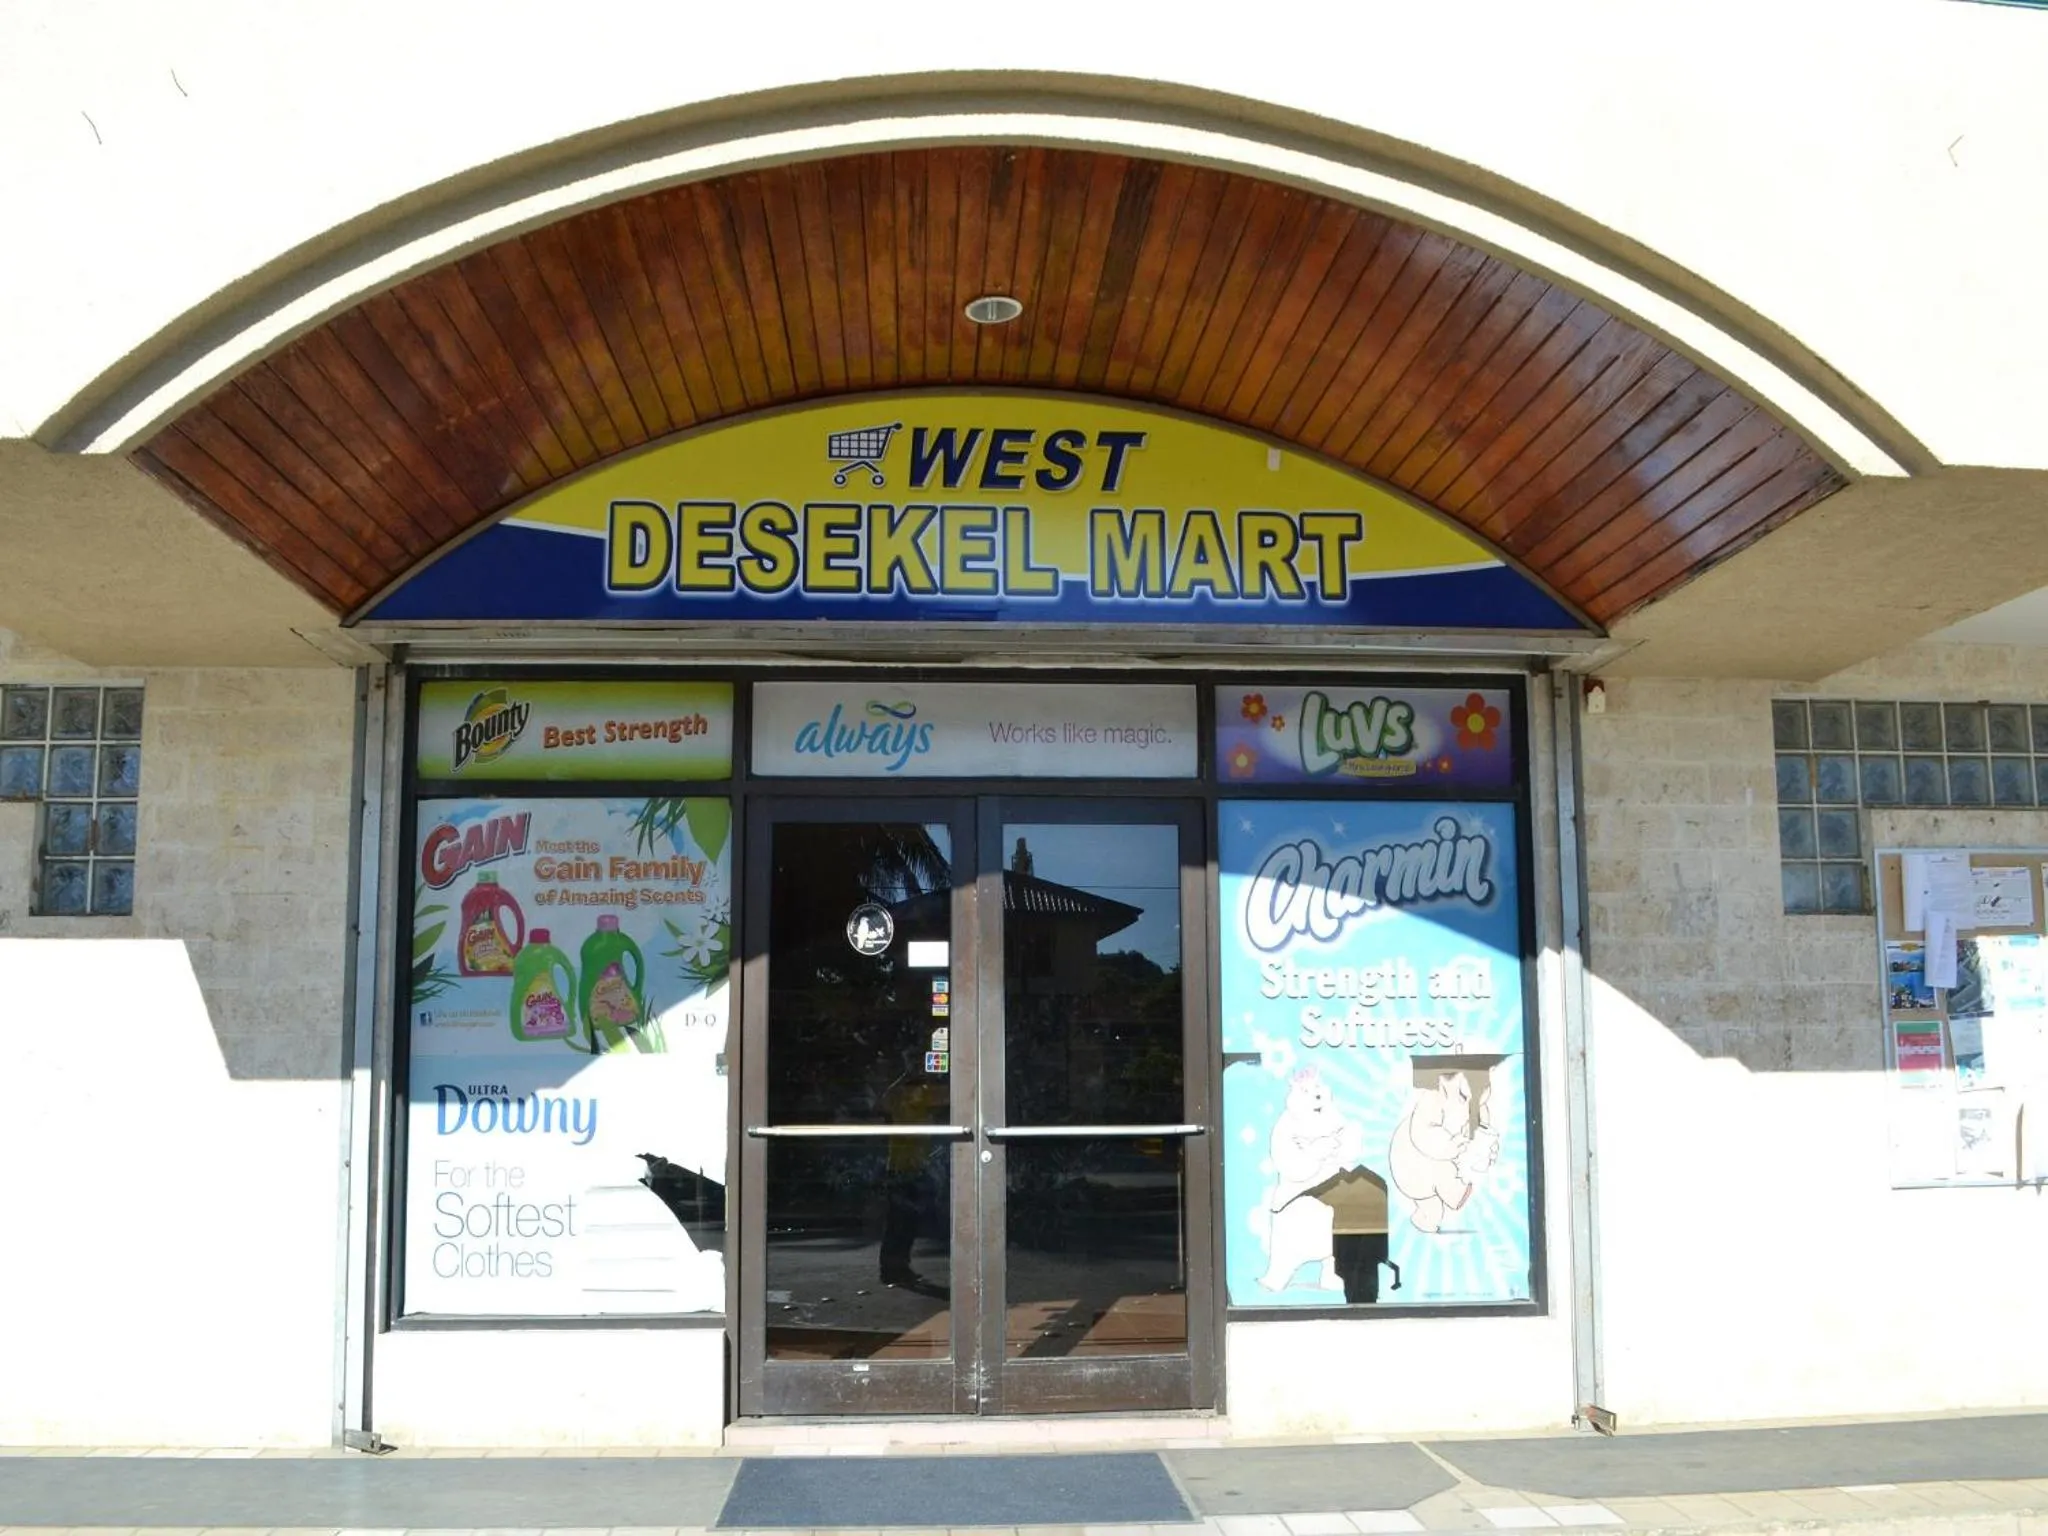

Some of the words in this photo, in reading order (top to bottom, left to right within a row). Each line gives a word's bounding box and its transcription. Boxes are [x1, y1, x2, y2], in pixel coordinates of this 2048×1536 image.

[908, 427, 1146, 494] WEST
[602, 499, 1061, 602] DESEKEL
[1088, 507, 1363, 609] MART
[453, 701, 529, 772] Bounty
[542, 726, 596, 749] Best
[603, 713, 708, 745] Strength
[794, 702, 935, 771] always
[989, 721, 1057, 744] Works
[1062, 721, 1098, 744] like
[1103, 722, 1172, 749] magic.
[534, 856, 602, 882] Gain
[609, 855, 707, 888] Family
[1246, 816, 1494, 951] Charmin
[535, 889, 557, 905] of
[559, 888, 638, 910] Amazing
[640, 888, 706, 906] Scents
[1260, 958, 1417, 1007] Strength
[1428, 959, 1491, 998] and
[1300, 1008, 1455, 1048] Softness
[468, 1085, 508, 1095] ULTRA
[433, 1084, 597, 1145] Downy
[434, 1160, 476, 1188] For
[484, 1160, 525, 1188] the
[434, 1191, 577, 1238] Softest
[433, 1242, 553, 1278] Clothes
